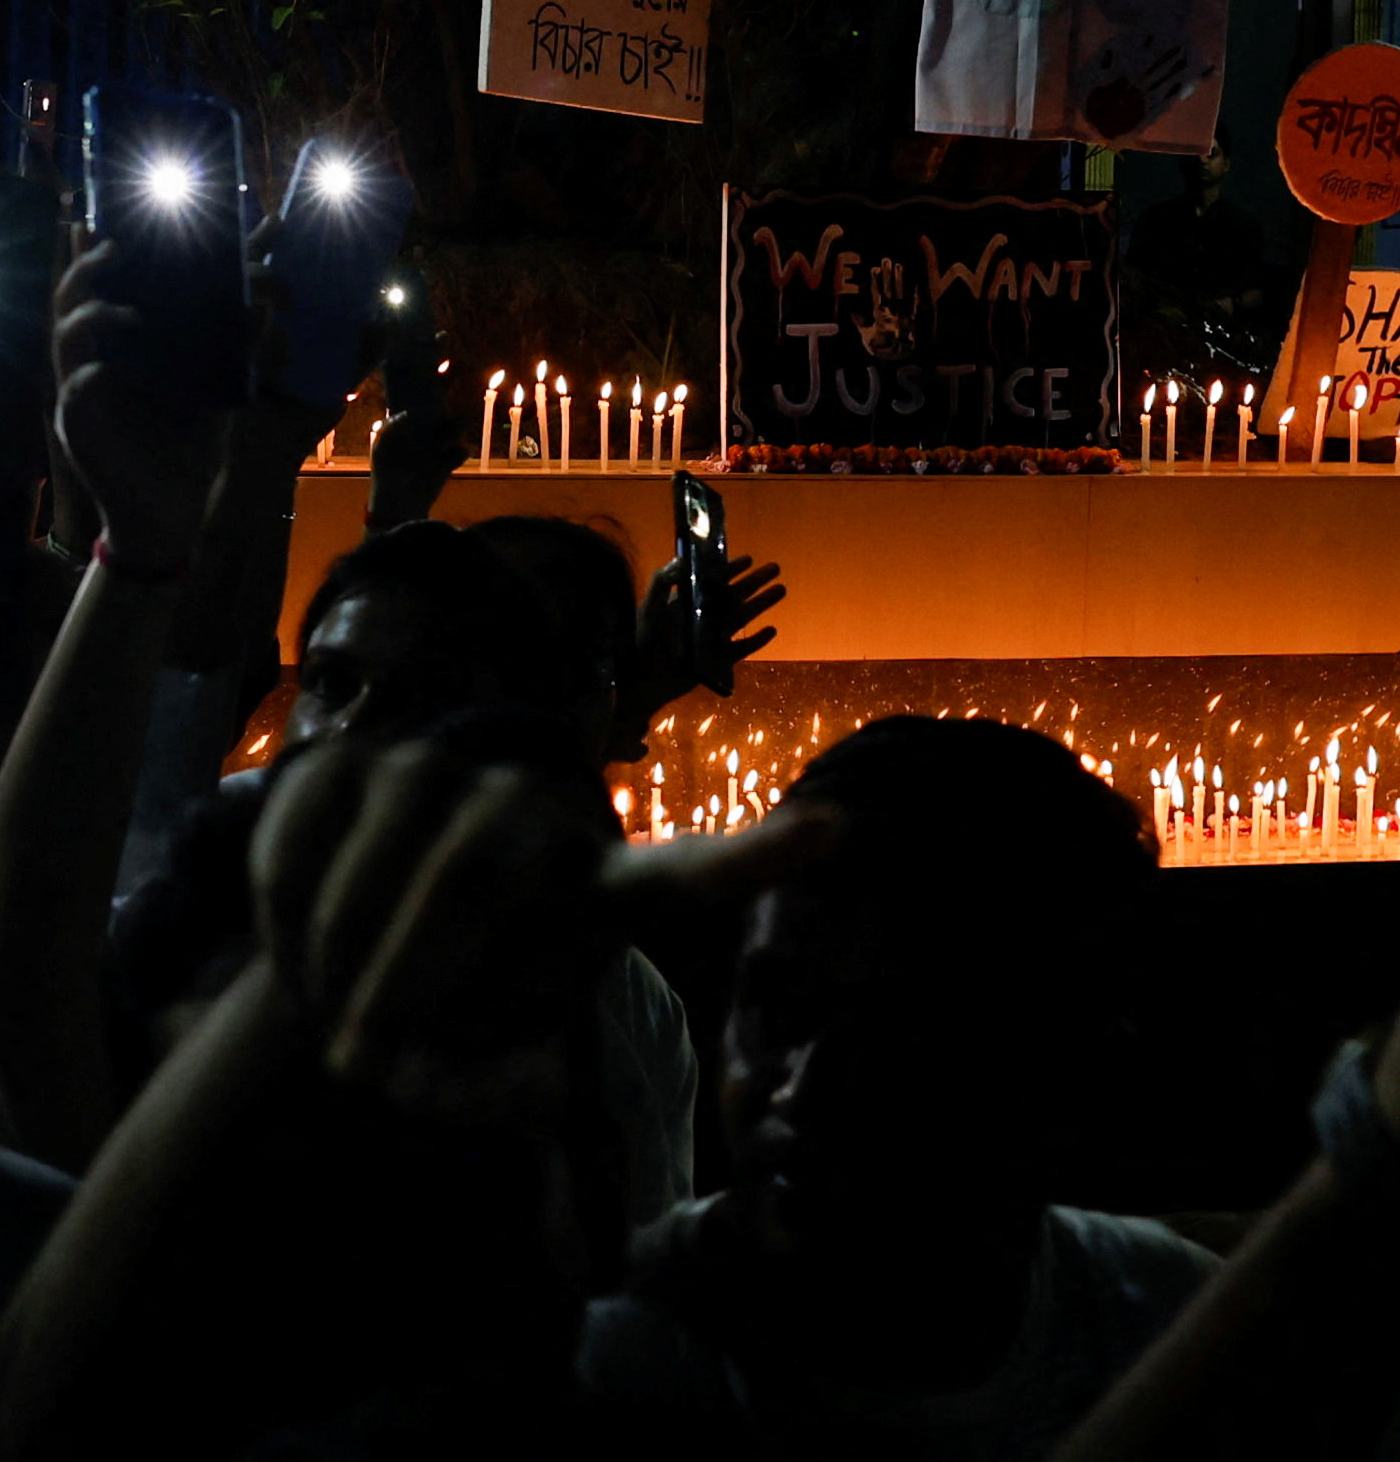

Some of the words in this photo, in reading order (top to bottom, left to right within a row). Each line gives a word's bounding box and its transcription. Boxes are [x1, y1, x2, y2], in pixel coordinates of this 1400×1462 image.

[528, 2, 612, 79] বিচার
[753, 223, 862, 296] WE
[918, 232, 1093, 303] WANT
[771, 322, 1073, 427] JUSTICE
